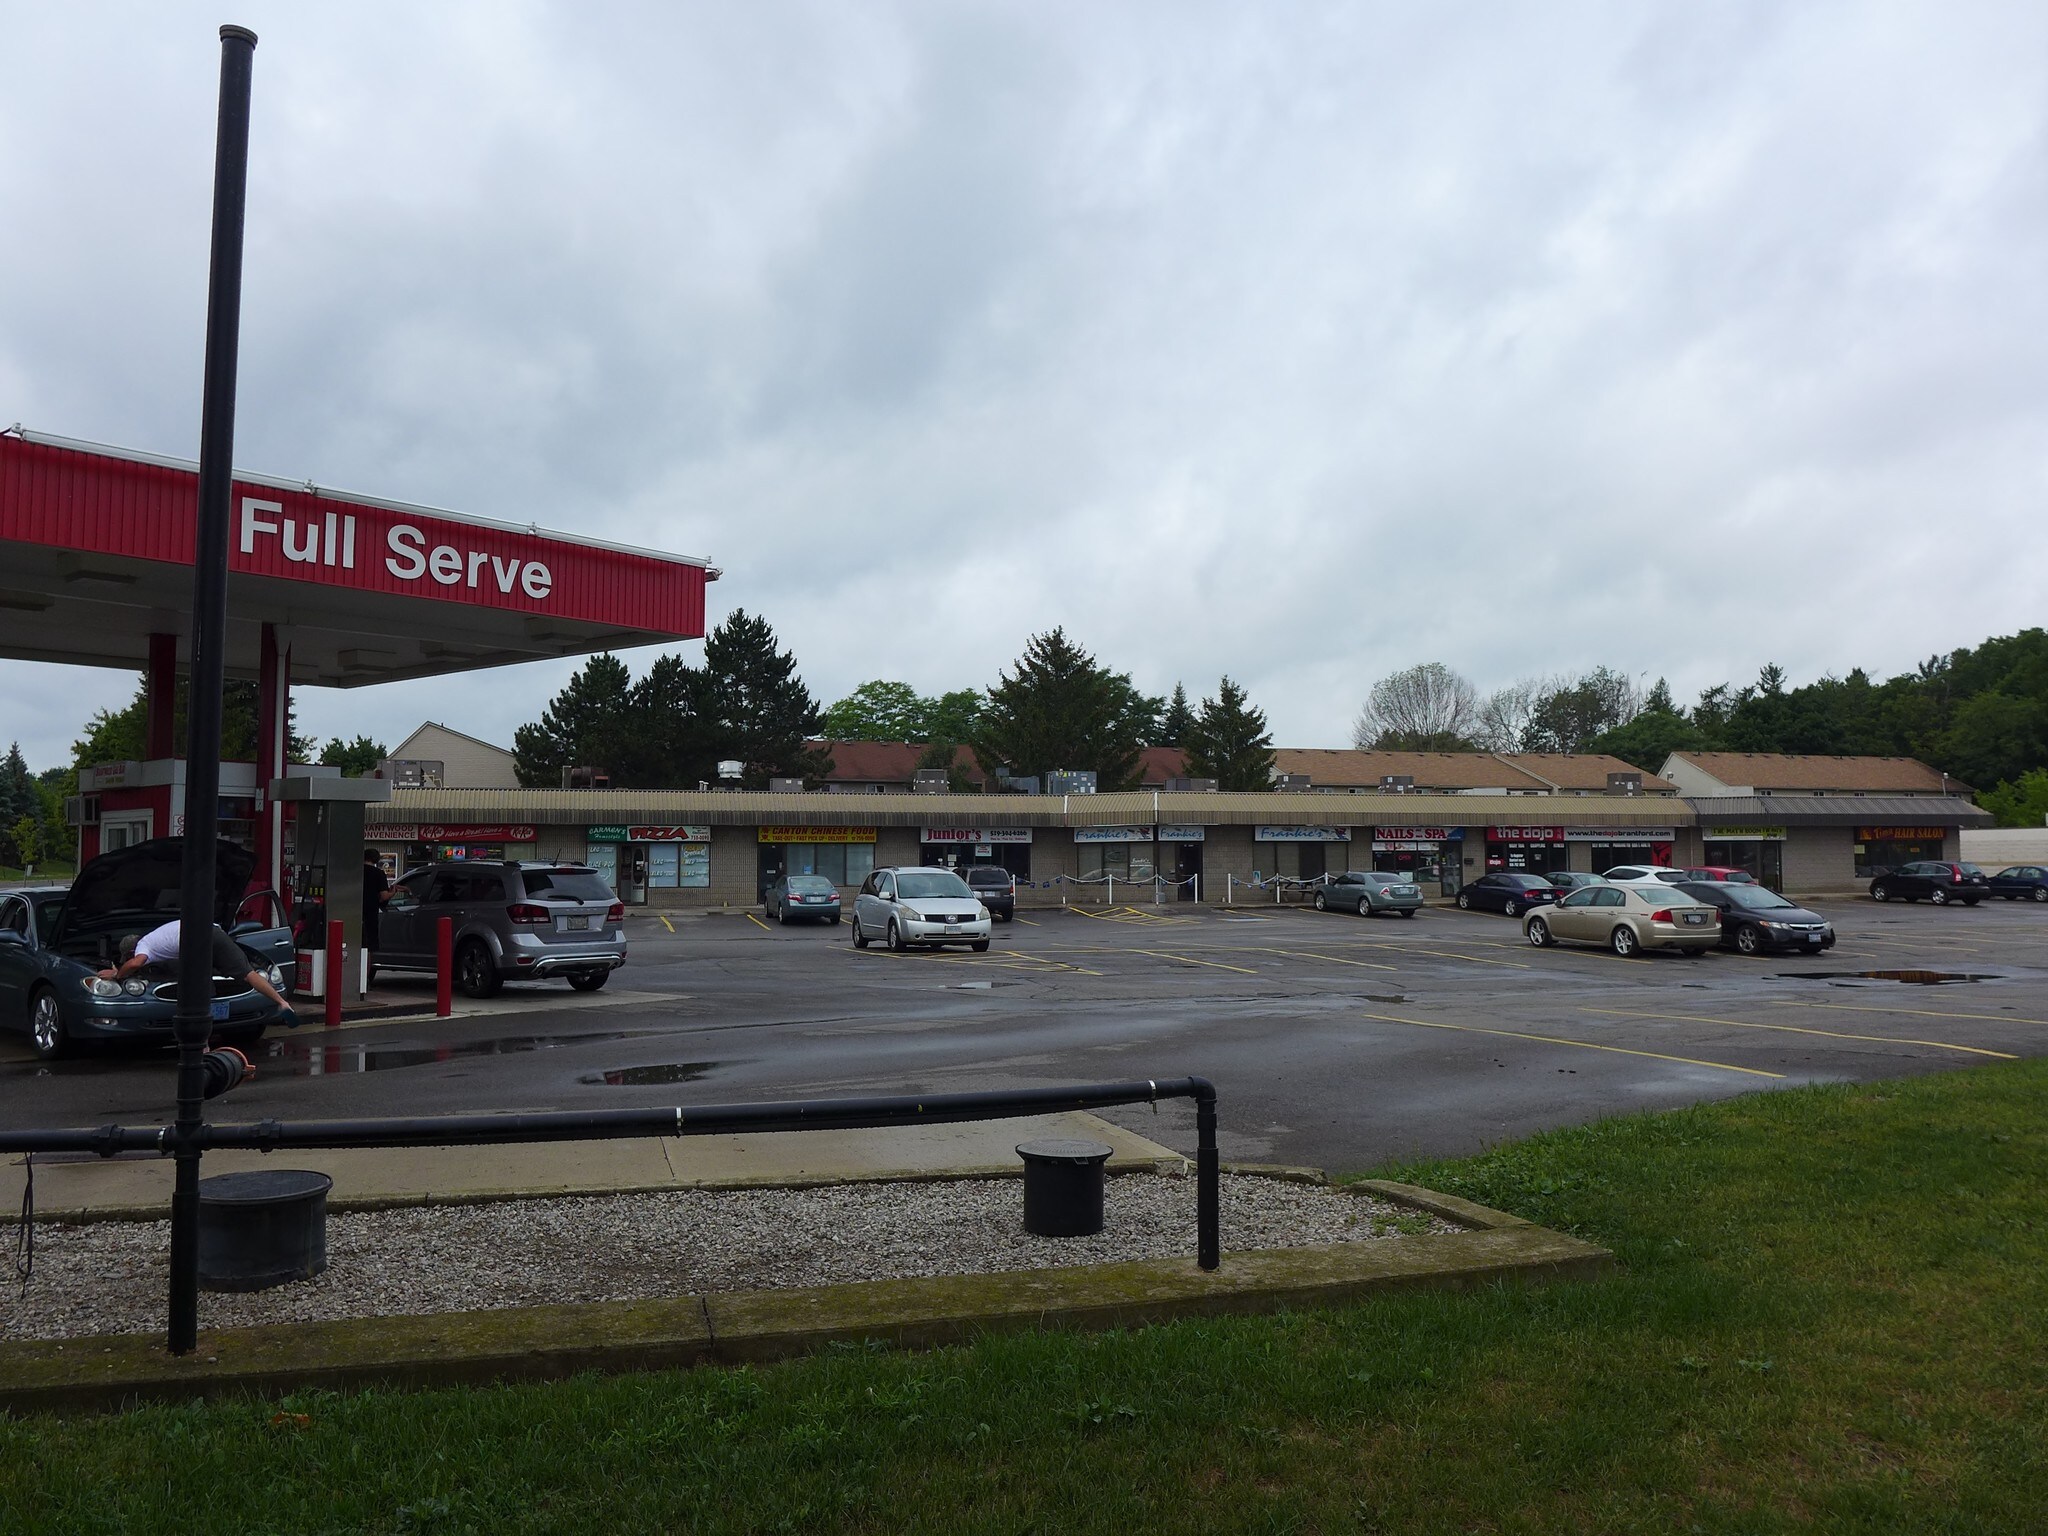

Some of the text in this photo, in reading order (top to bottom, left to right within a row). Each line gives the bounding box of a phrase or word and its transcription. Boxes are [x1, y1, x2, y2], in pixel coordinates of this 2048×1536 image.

[240, 496, 552, 599] Full Serve
[588, 825, 626, 835] CARMEN'S
[628, 826, 690, 841] PIZZA
[772, 826, 875, 835] CANTON CHINESE FOOD
[926, 828, 982, 841] Junior's
[1075, 826, 1129, 839] Frankie's
[1160, 827, 1203, 838] Frankie's
[1261, 826, 1322, 839] Frankie's
[1376, 828, 1414, 839] NAILS
[1424, 828, 1447, 839] SPA
[1497, 826, 1520, 838] the
[1523, 826, 1553, 841] dojo
[1567, 829, 1671, 838] www.thedojobrantford.com
[1894, 827, 1915, 838] HAIR
[1917, 827, 1945, 838] SALON
